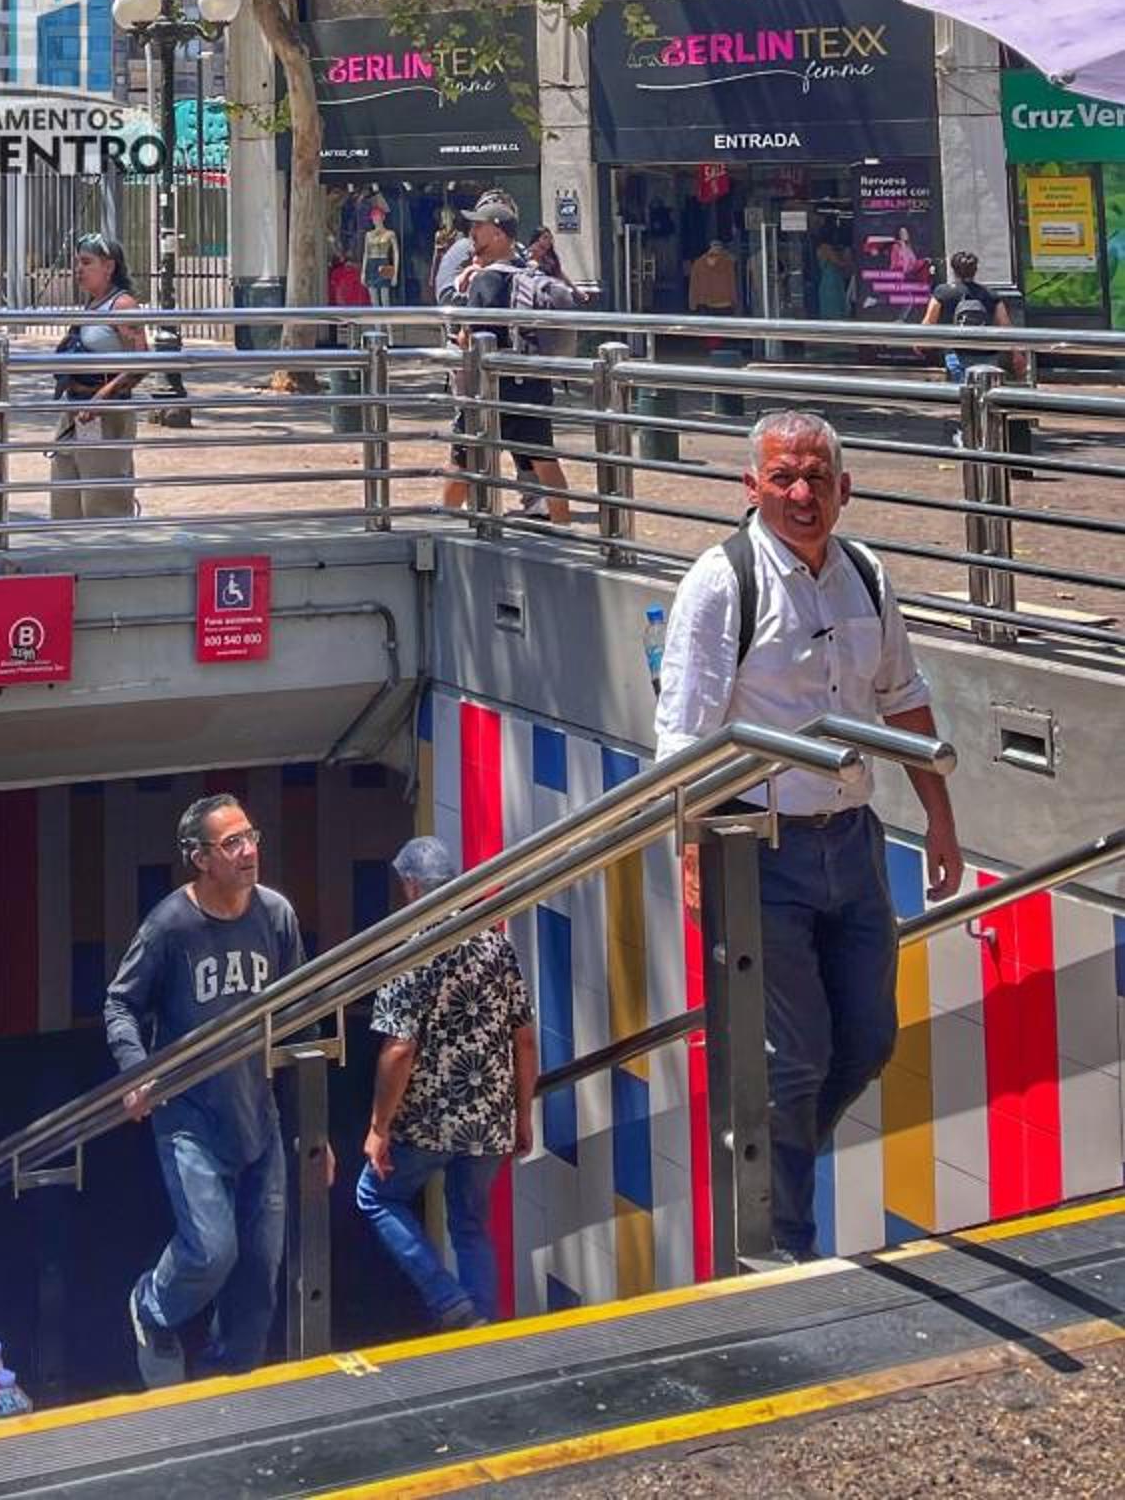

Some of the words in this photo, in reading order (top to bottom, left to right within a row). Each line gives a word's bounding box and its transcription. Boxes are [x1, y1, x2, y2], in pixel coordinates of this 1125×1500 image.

[1011, 103, 1075, 129] Cruz
[714, 132, 802, 150] ENTRADA
[860, 176, 907, 186] Renueva
[874, 187, 908, 197] closet
[909, 188, 930, 197] con
[18, 625, 34, 646] B
[195, 951, 268, 1004] GAP
